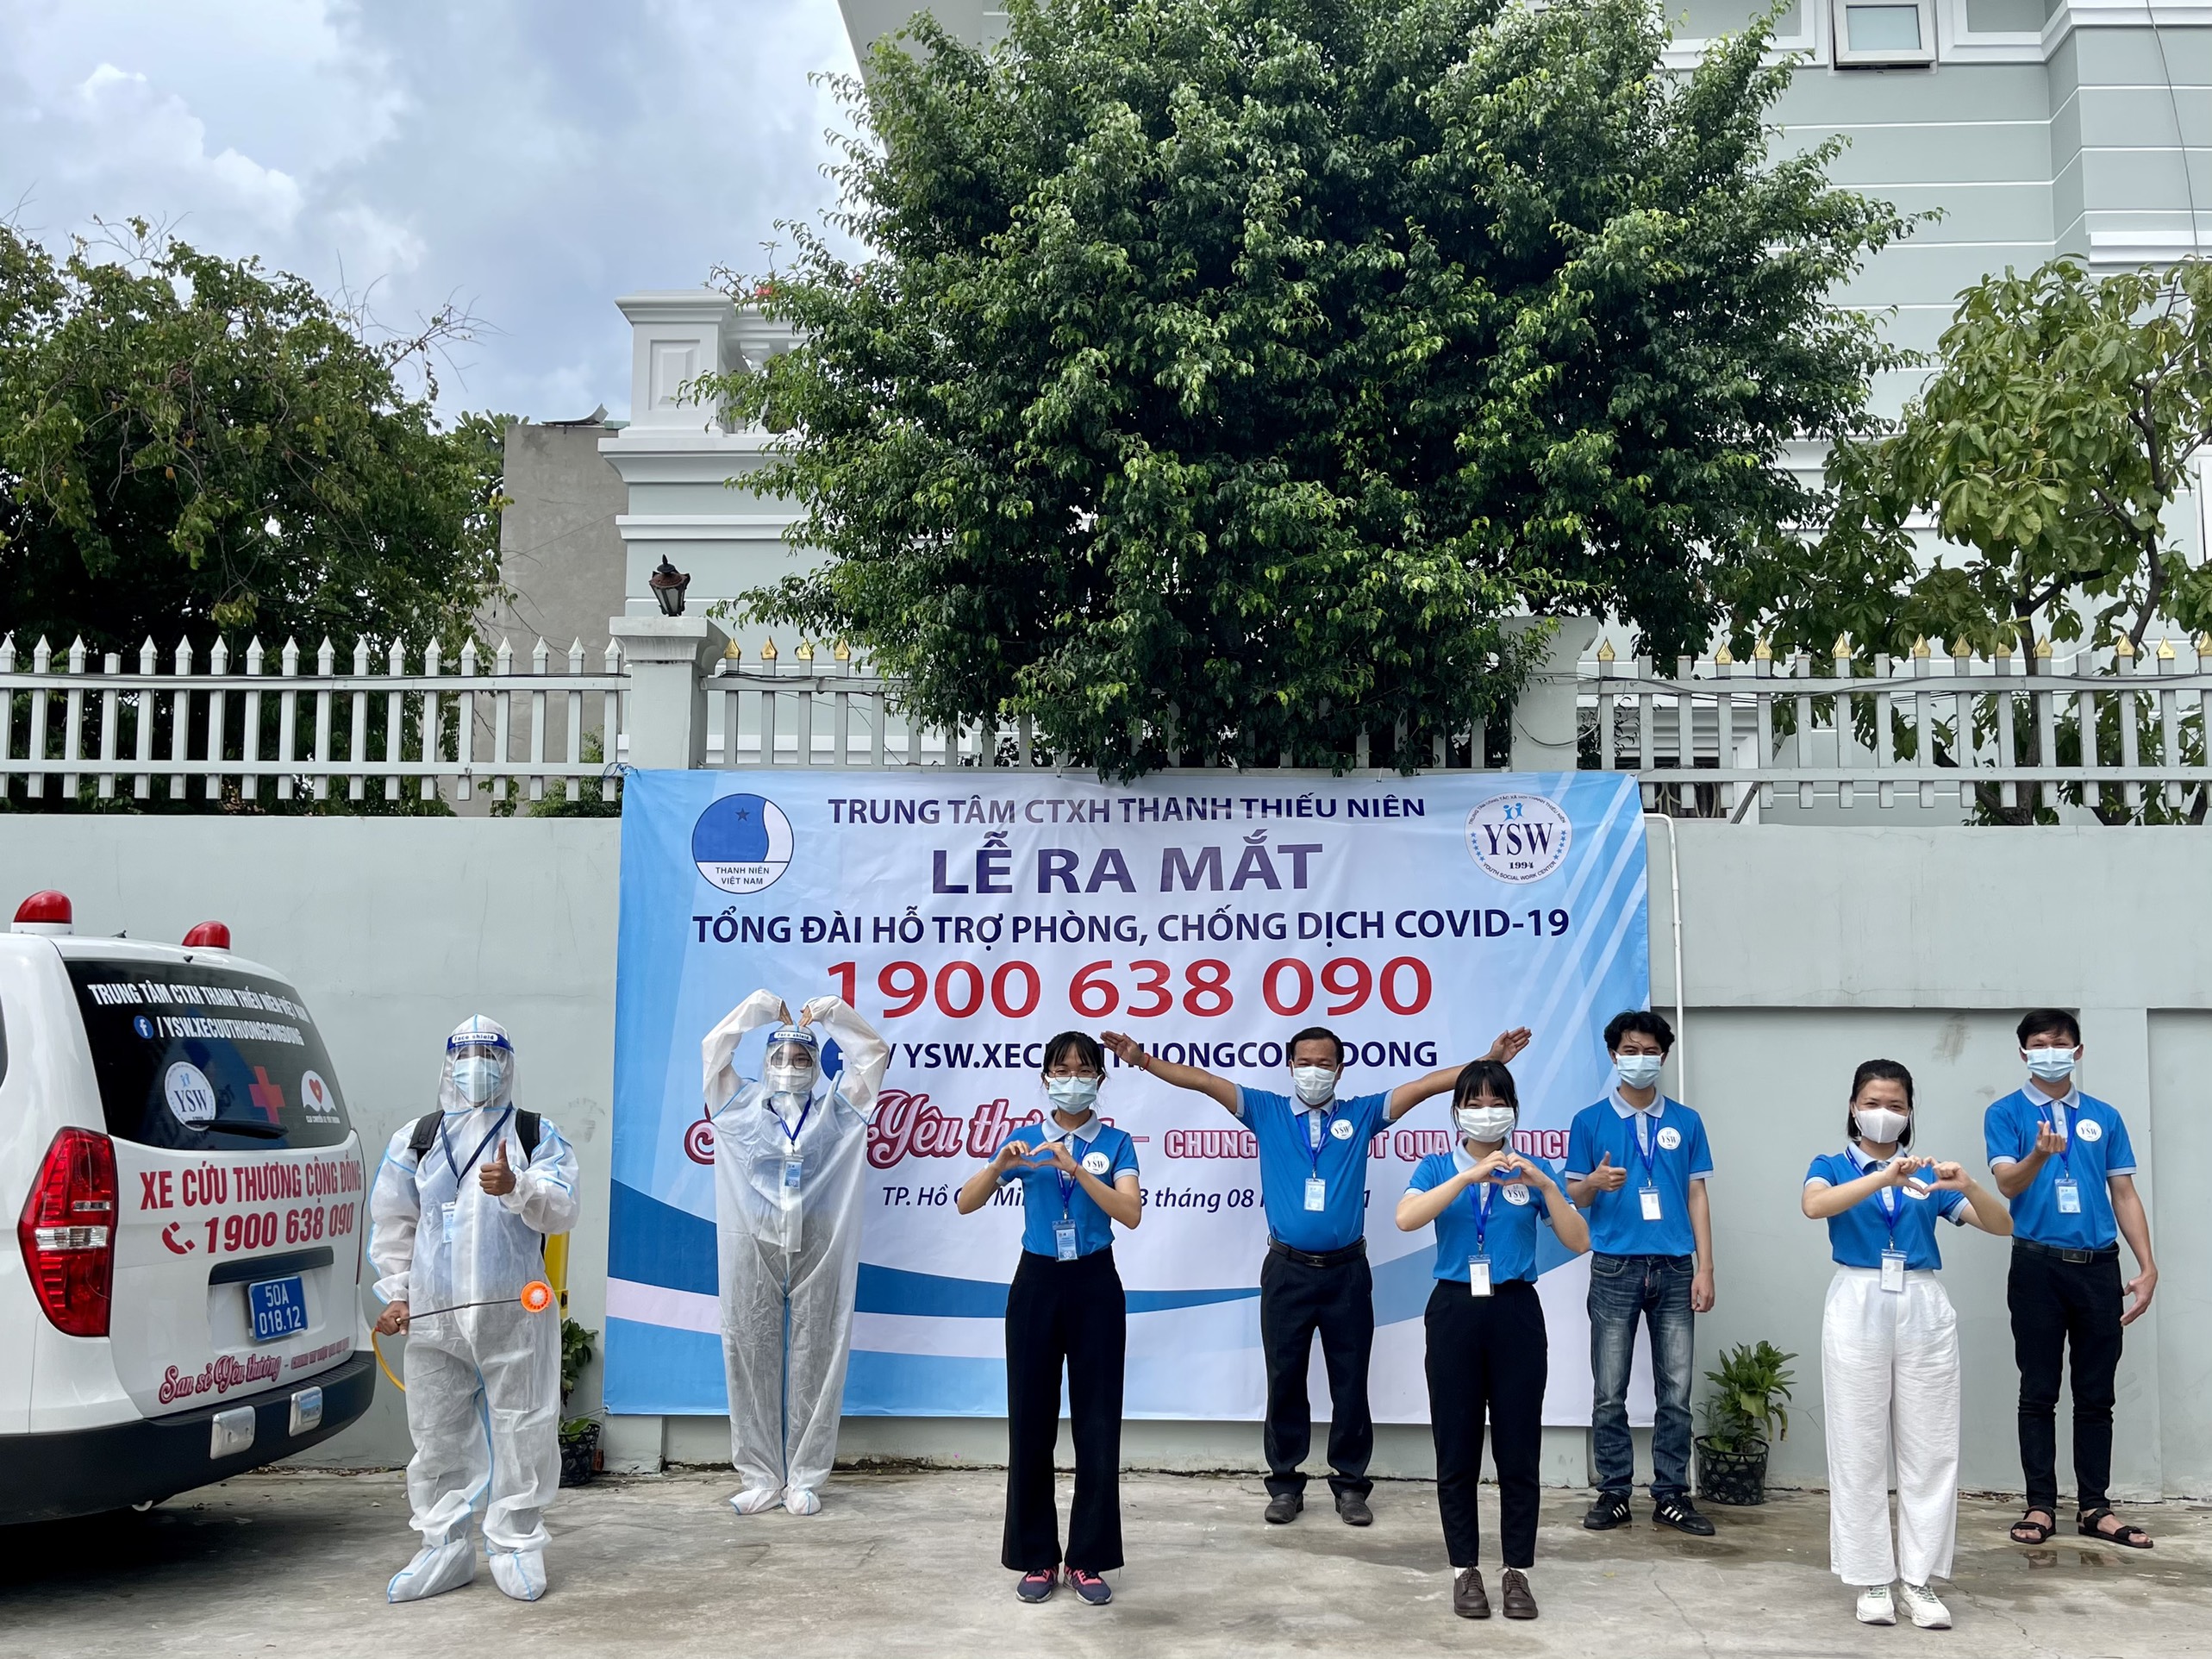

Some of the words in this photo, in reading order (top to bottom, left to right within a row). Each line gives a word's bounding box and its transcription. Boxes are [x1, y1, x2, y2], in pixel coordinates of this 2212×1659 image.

[828, 798, 940, 824] TRUNG
[953, 794, 1015, 824] TÂM
[1024, 798, 1110, 823] CTXH
[1118, 797, 1232, 823] THANH
[1240, 792, 1336, 818] THIẾU
[1347, 793, 1426, 817] NIÊN
[1483, 823, 1553, 856] YSW
[748, 865, 771, 874] NIÊN
[932, 830, 1013, 895] LỄ
[1037, 847, 1137, 895] RA
[1159, 829, 1323, 894] MẮT
[1483, 862, 1500, 876] YOUTH
[1499, 872, 1520, 881] SOCIAL
[1520, 873, 1538, 881] WORK
[1537, 861, 1557, 876] CENTER
[1509, 861, 1534, 870] 1994
[721, 875, 741, 886] VIỆT
[692, 905, 790, 943] TỔNG
[800, 909, 860, 943] ĐÀI
[872, 905, 924, 943] HỖ
[931, 912, 1003, 951] TRỢ
[1011, 908, 1148, 947] PHÒNG,
[1157, 905, 1288, 942] CHỐNG
[1298, 910, 1384, 948] DỊCH
[1394, 907, 1570, 939] COVID-19
[87, 983, 141, 1005] TRUNG
[139, 980, 172, 1005] TÂM
[170, 983, 203, 1005] CTXH
[200, 986, 240, 1008] THANH
[233, 986, 264, 1010] THIẾU
[827, 960, 1040, 1019] 1900
[1068, 959, 1234, 1018] 638
[1262, 955, 1433, 1017] 090
[163, 1016, 305, 1047] YSW.XECUUTHUONGCONGDONG
[173, 1089, 208, 1112] YSW
[866, 1089, 964, 1169] Yêu
[2080, 1126, 2098, 1136] YSW
[1164, 1130, 1258, 1159] CHUNG
[1394, 1130, 1452, 1161] QUA
[1086, 1160, 1105, 1168] YSW
[140, 1171, 174, 1210] XE
[182, 1161, 228, 1207] CỨU
[233, 1161, 302, 1203] THƯƠNG
[305, 1155, 338, 1204] CỘNG
[339, 1151, 362, 1193] ĐỒNG
[1508, 1189, 1526, 1199] YSW
[883, 1186, 911, 1206] TP.
[917, 1184, 948, 1207] Hồ
[1155, 1187, 1221, 1213] tháng
[1228, 1188, 1254, 1208] 08
[204, 1211, 278, 1254] 1900
[285, 1206, 325, 1244] 638
[328, 1202, 354, 1237] 090
[265, 1283, 290, 1307] 50A
[259, 1305, 302, 1336] 018.12
[159, 1365, 194, 1405] San
[246, 1353, 283, 1382] thương
